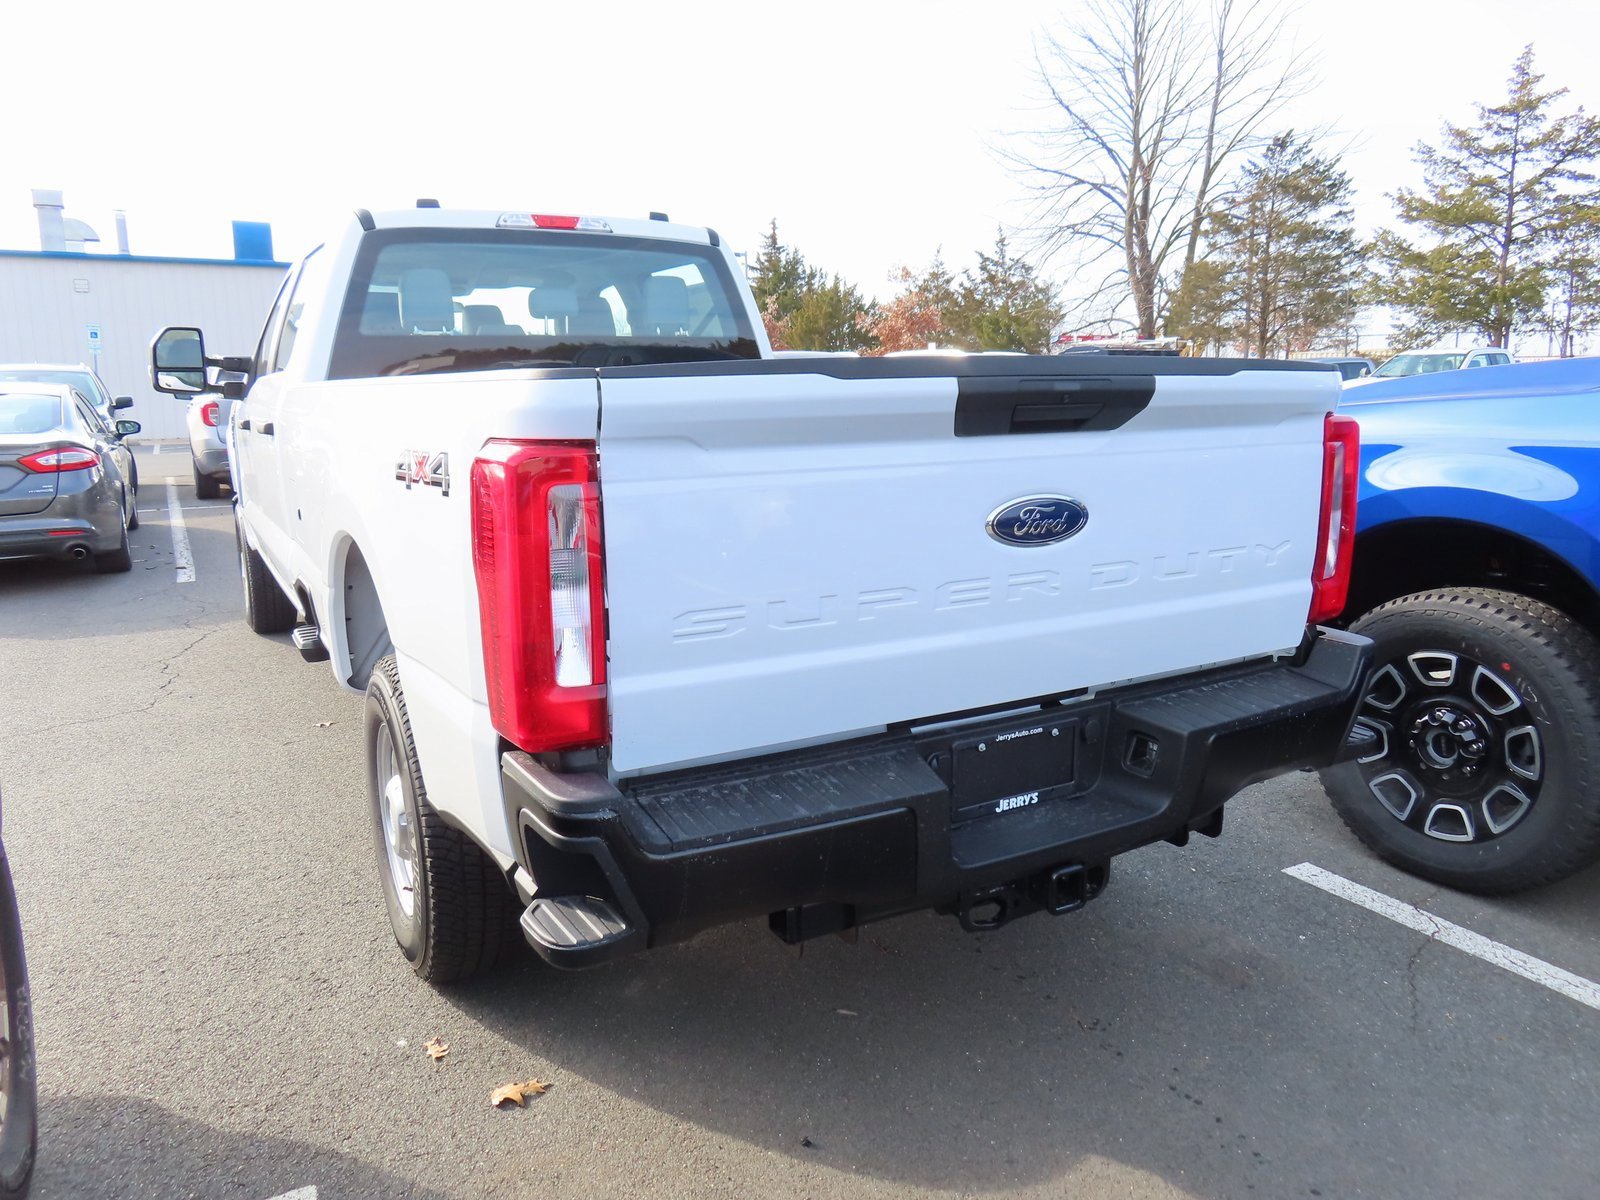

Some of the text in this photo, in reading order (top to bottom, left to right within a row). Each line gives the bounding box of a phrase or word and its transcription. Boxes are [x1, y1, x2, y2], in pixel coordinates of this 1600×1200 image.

[1014, 506, 1069, 536] Ford
[672, 539, 1292, 644] SUPER DUTY
[995, 727, 1043, 742] JerrysAuto.com
[995, 792, 1039, 813] JERRY'S
